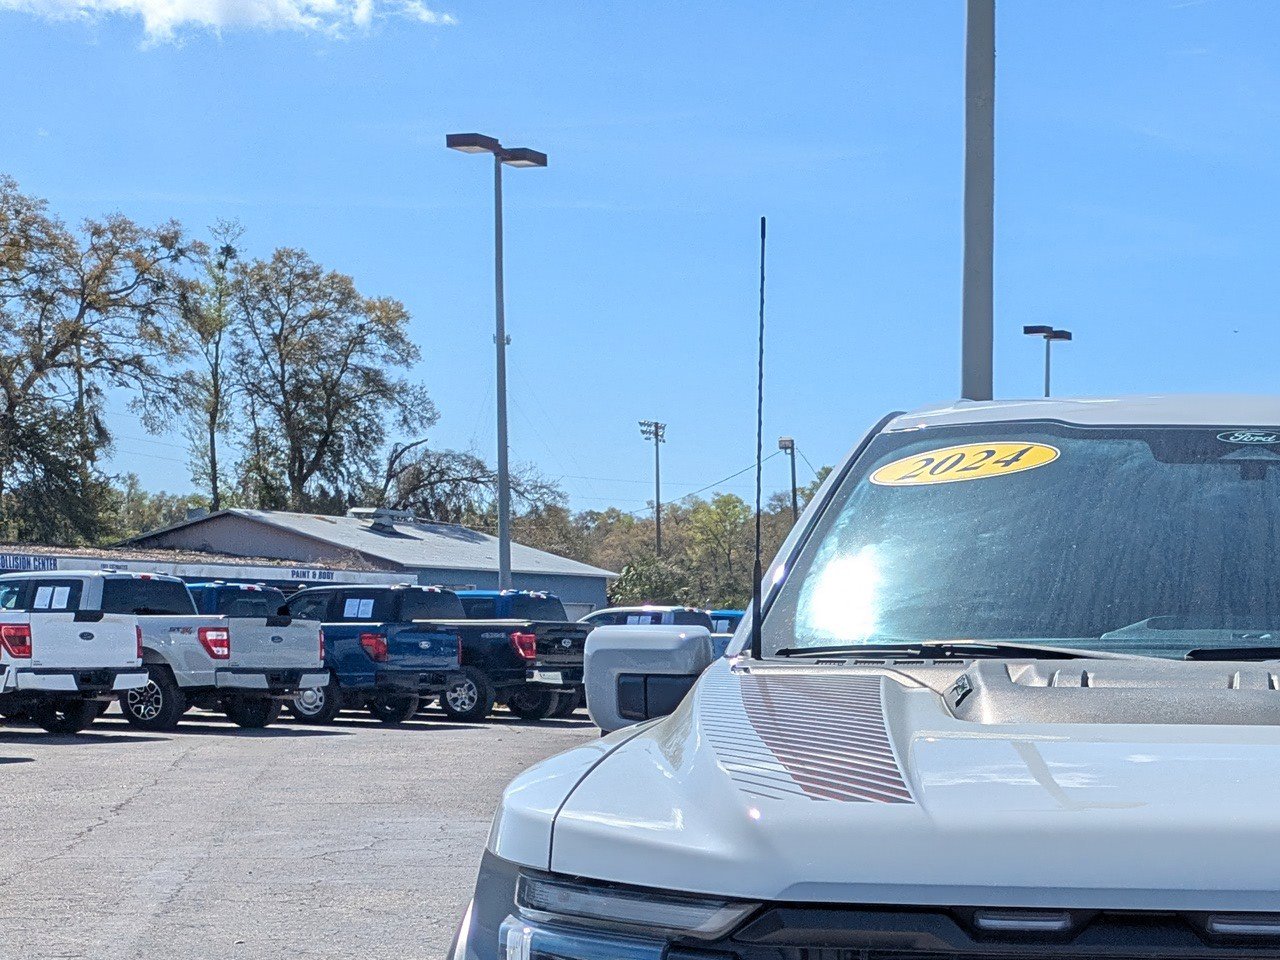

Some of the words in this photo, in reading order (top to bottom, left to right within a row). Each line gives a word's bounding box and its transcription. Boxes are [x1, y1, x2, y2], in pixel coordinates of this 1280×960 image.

[895, 446, 1035, 482] 2024
[33, 557, 58, 571] CENTER
[291, 569, 311, 579] PAINT
[312, 571, 317, 579] &
[318, 571, 335, 580] BODY
